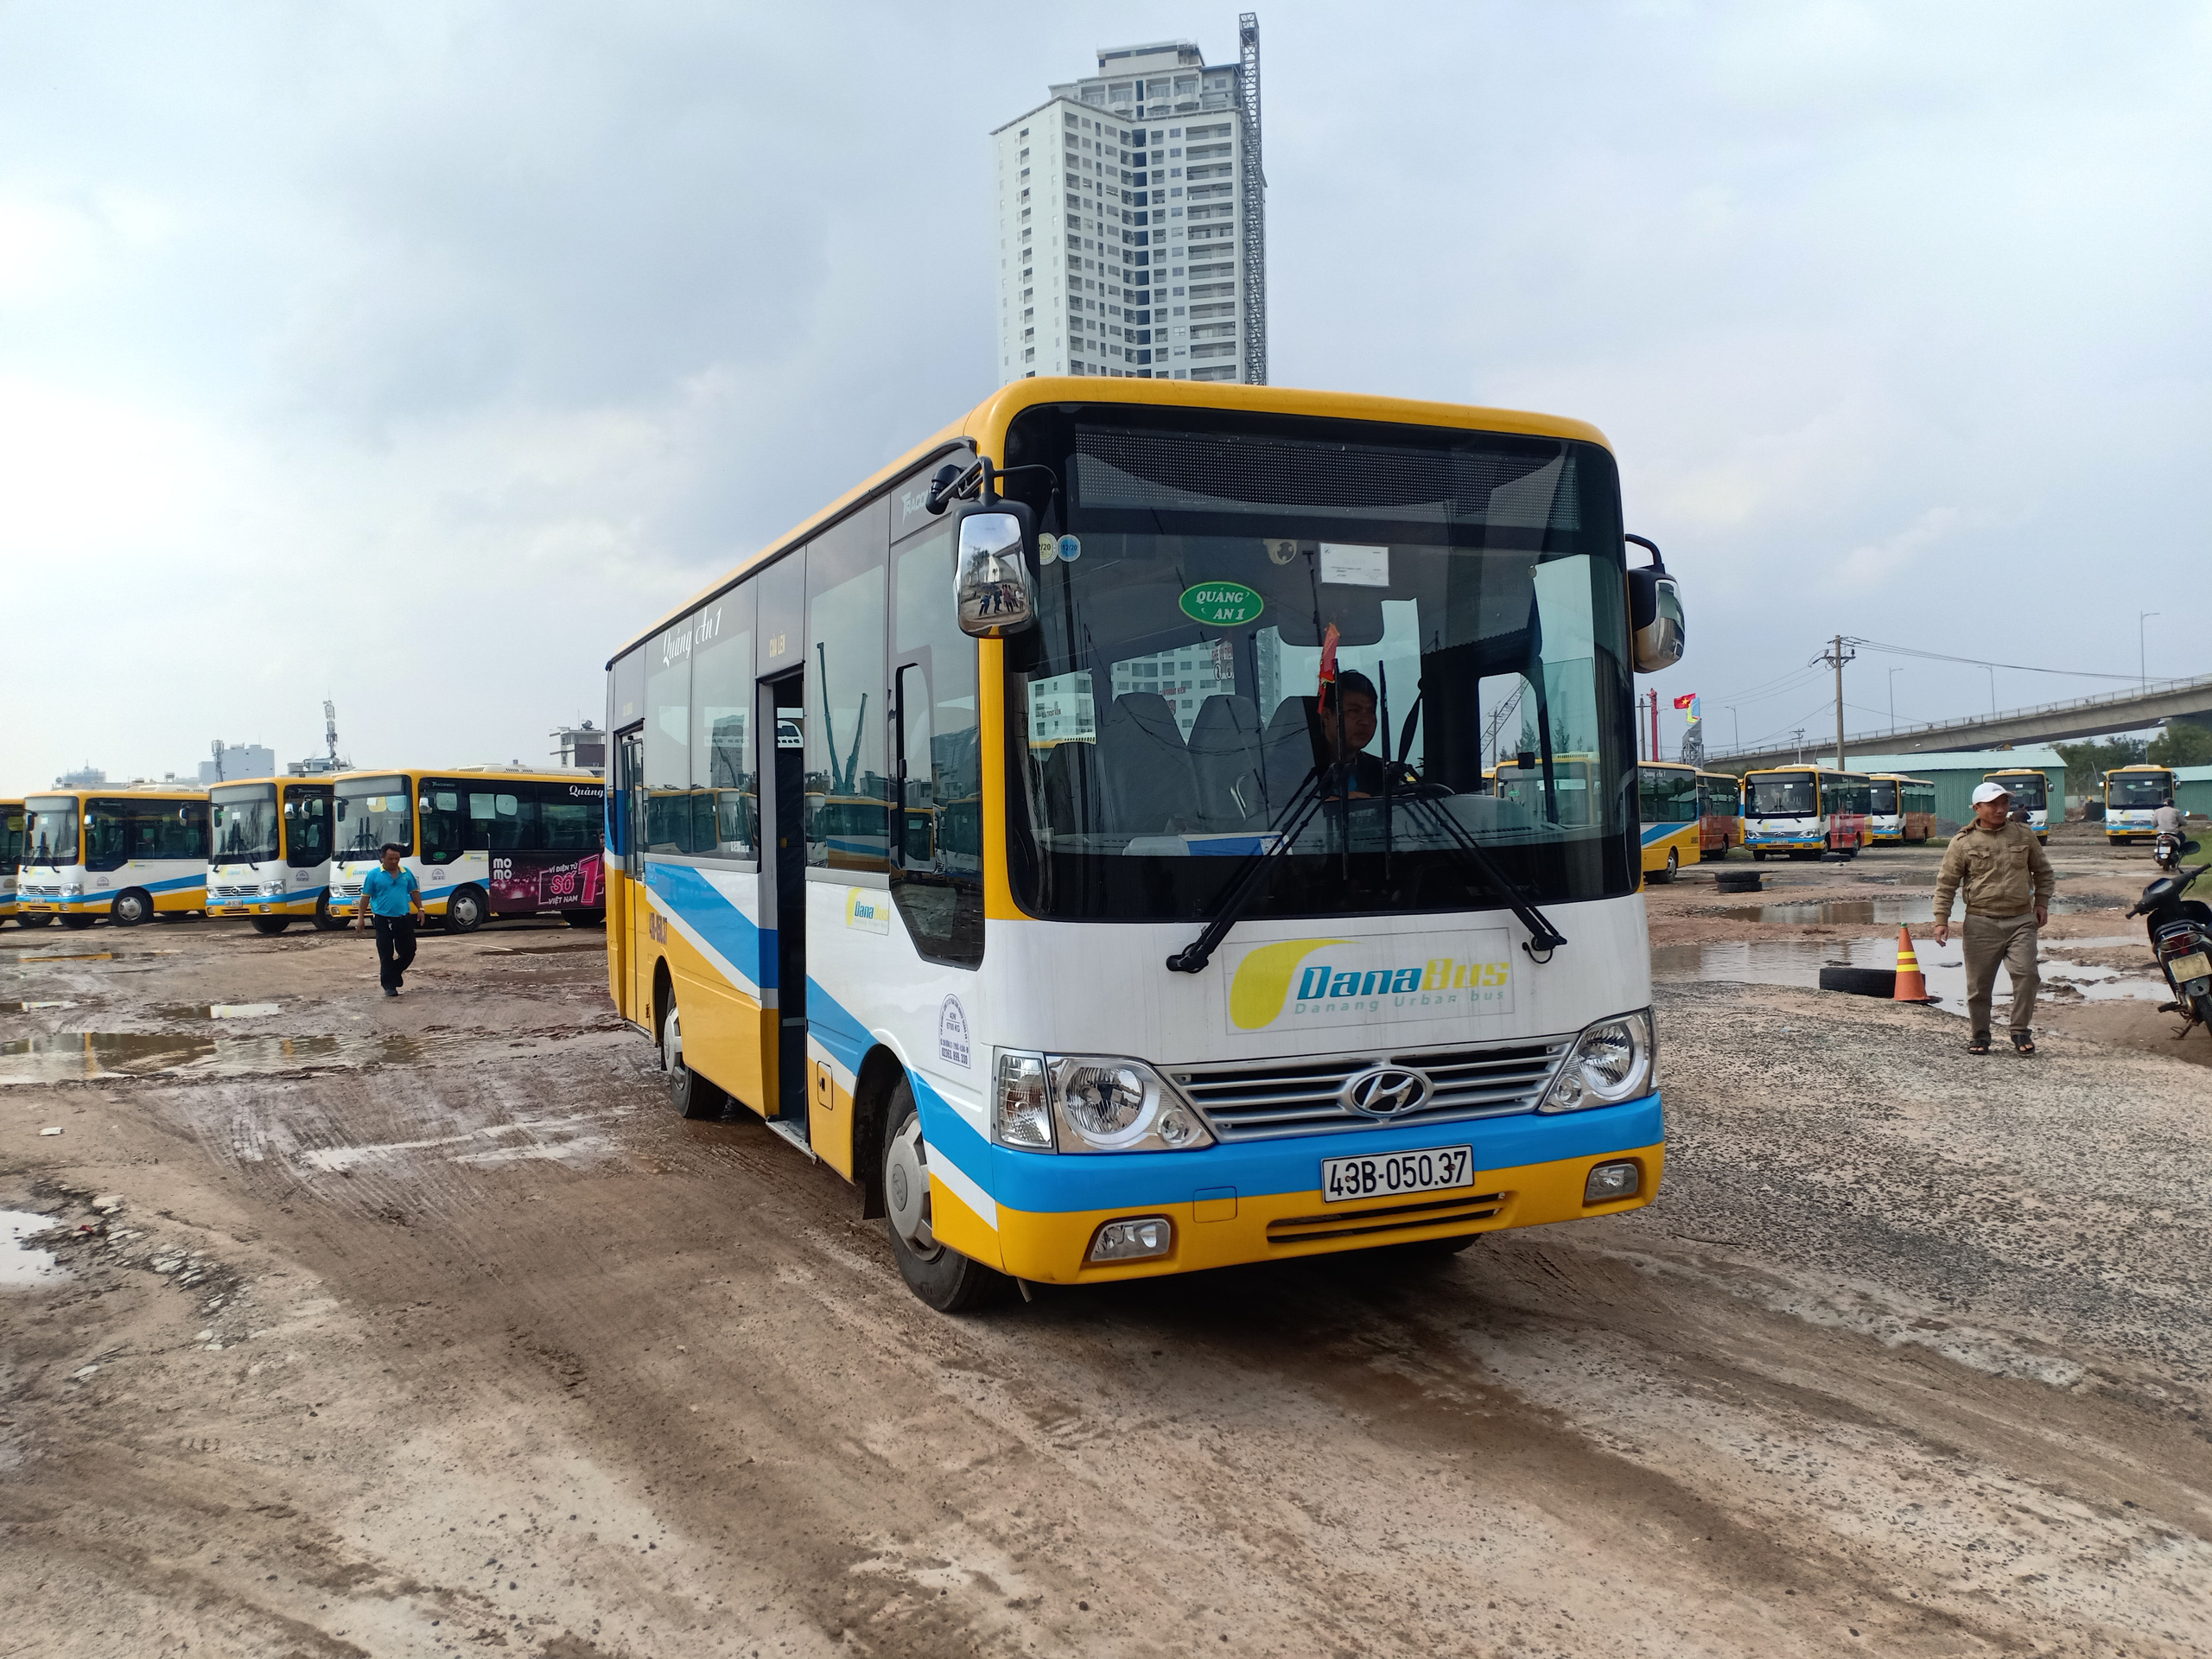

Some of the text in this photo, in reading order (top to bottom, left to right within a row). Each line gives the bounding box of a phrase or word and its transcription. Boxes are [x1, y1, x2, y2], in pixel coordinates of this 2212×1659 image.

[1196, 588, 1243, 604] QUẢNG
[1213, 607, 1245, 620] AN 1
[663, 606, 722, 668] Quảng An 1
[569, 785, 604, 798] Quảng
[550, 854, 601, 906] SỐ 1
[548, 895, 578, 906] VIỆT NAM
[855, 900, 889, 922] DanaBus
[1297, 958, 1510, 1001] DanaBus
[1294, 990, 1503, 1014] Danang Urban bus
[1330, 1151, 1467, 1196] 43B-050.37
